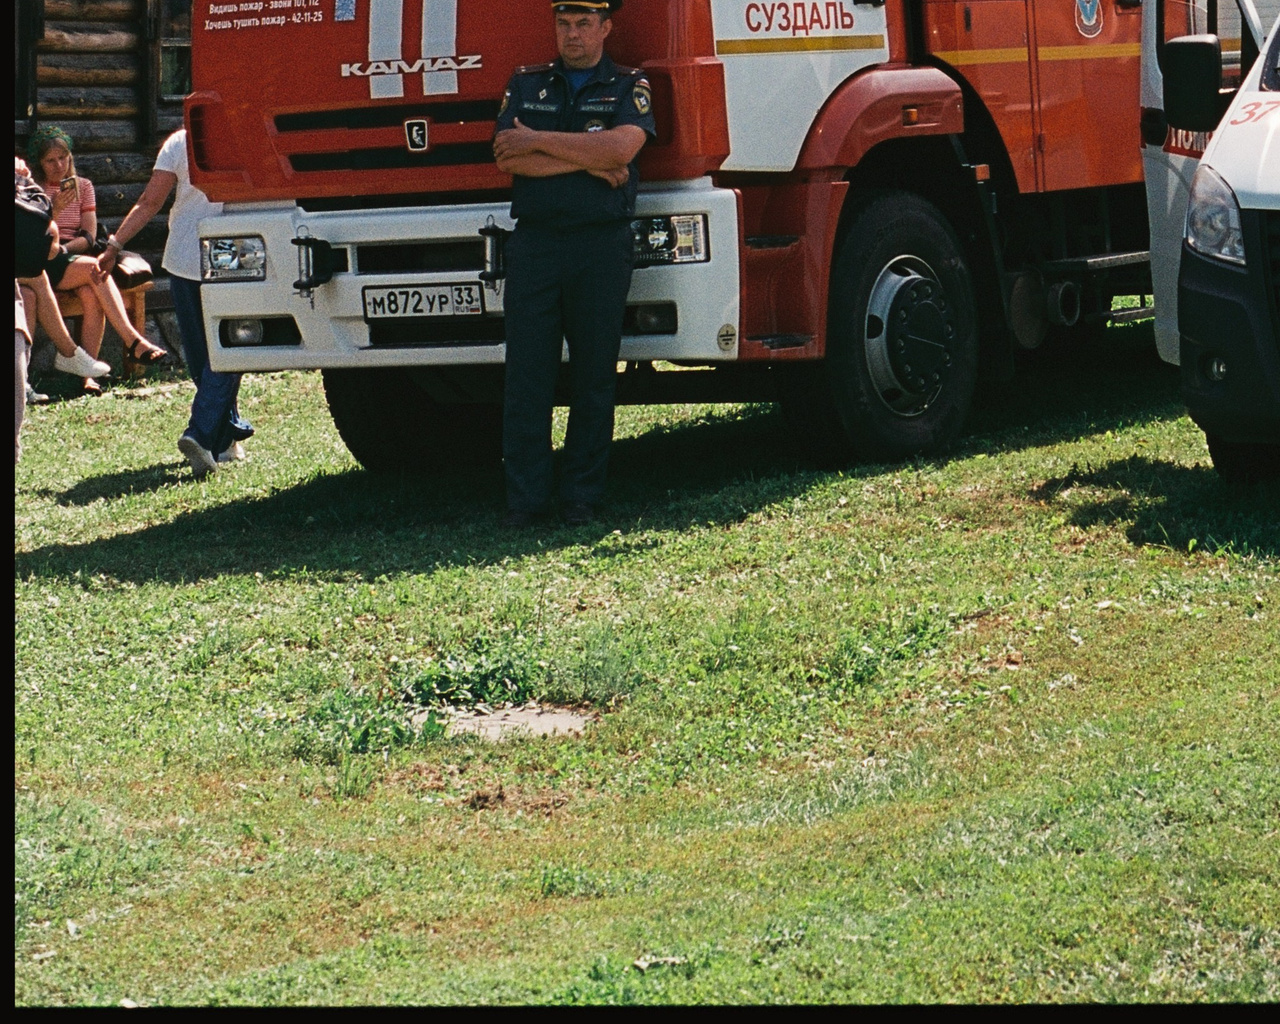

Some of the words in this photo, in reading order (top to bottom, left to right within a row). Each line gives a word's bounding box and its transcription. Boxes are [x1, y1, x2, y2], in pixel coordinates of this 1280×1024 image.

[209, 3, 238, 15] Видишь
[239, 1, 264, 13] пожар
[269, 0, 292, 10] звони
[204, 19, 232, 31] Хочешь
[233, 17, 260, 30] тушить
[261, 15, 286, 27] пожар
[292, 10, 323, 23] 42-11-25
[745, 1, 855, 36] СУЗДАЛЬ
[340, 54, 483, 77] KAMAZ
[453, 286, 474, 305] 33
[455, 305, 470, 313] RUS
